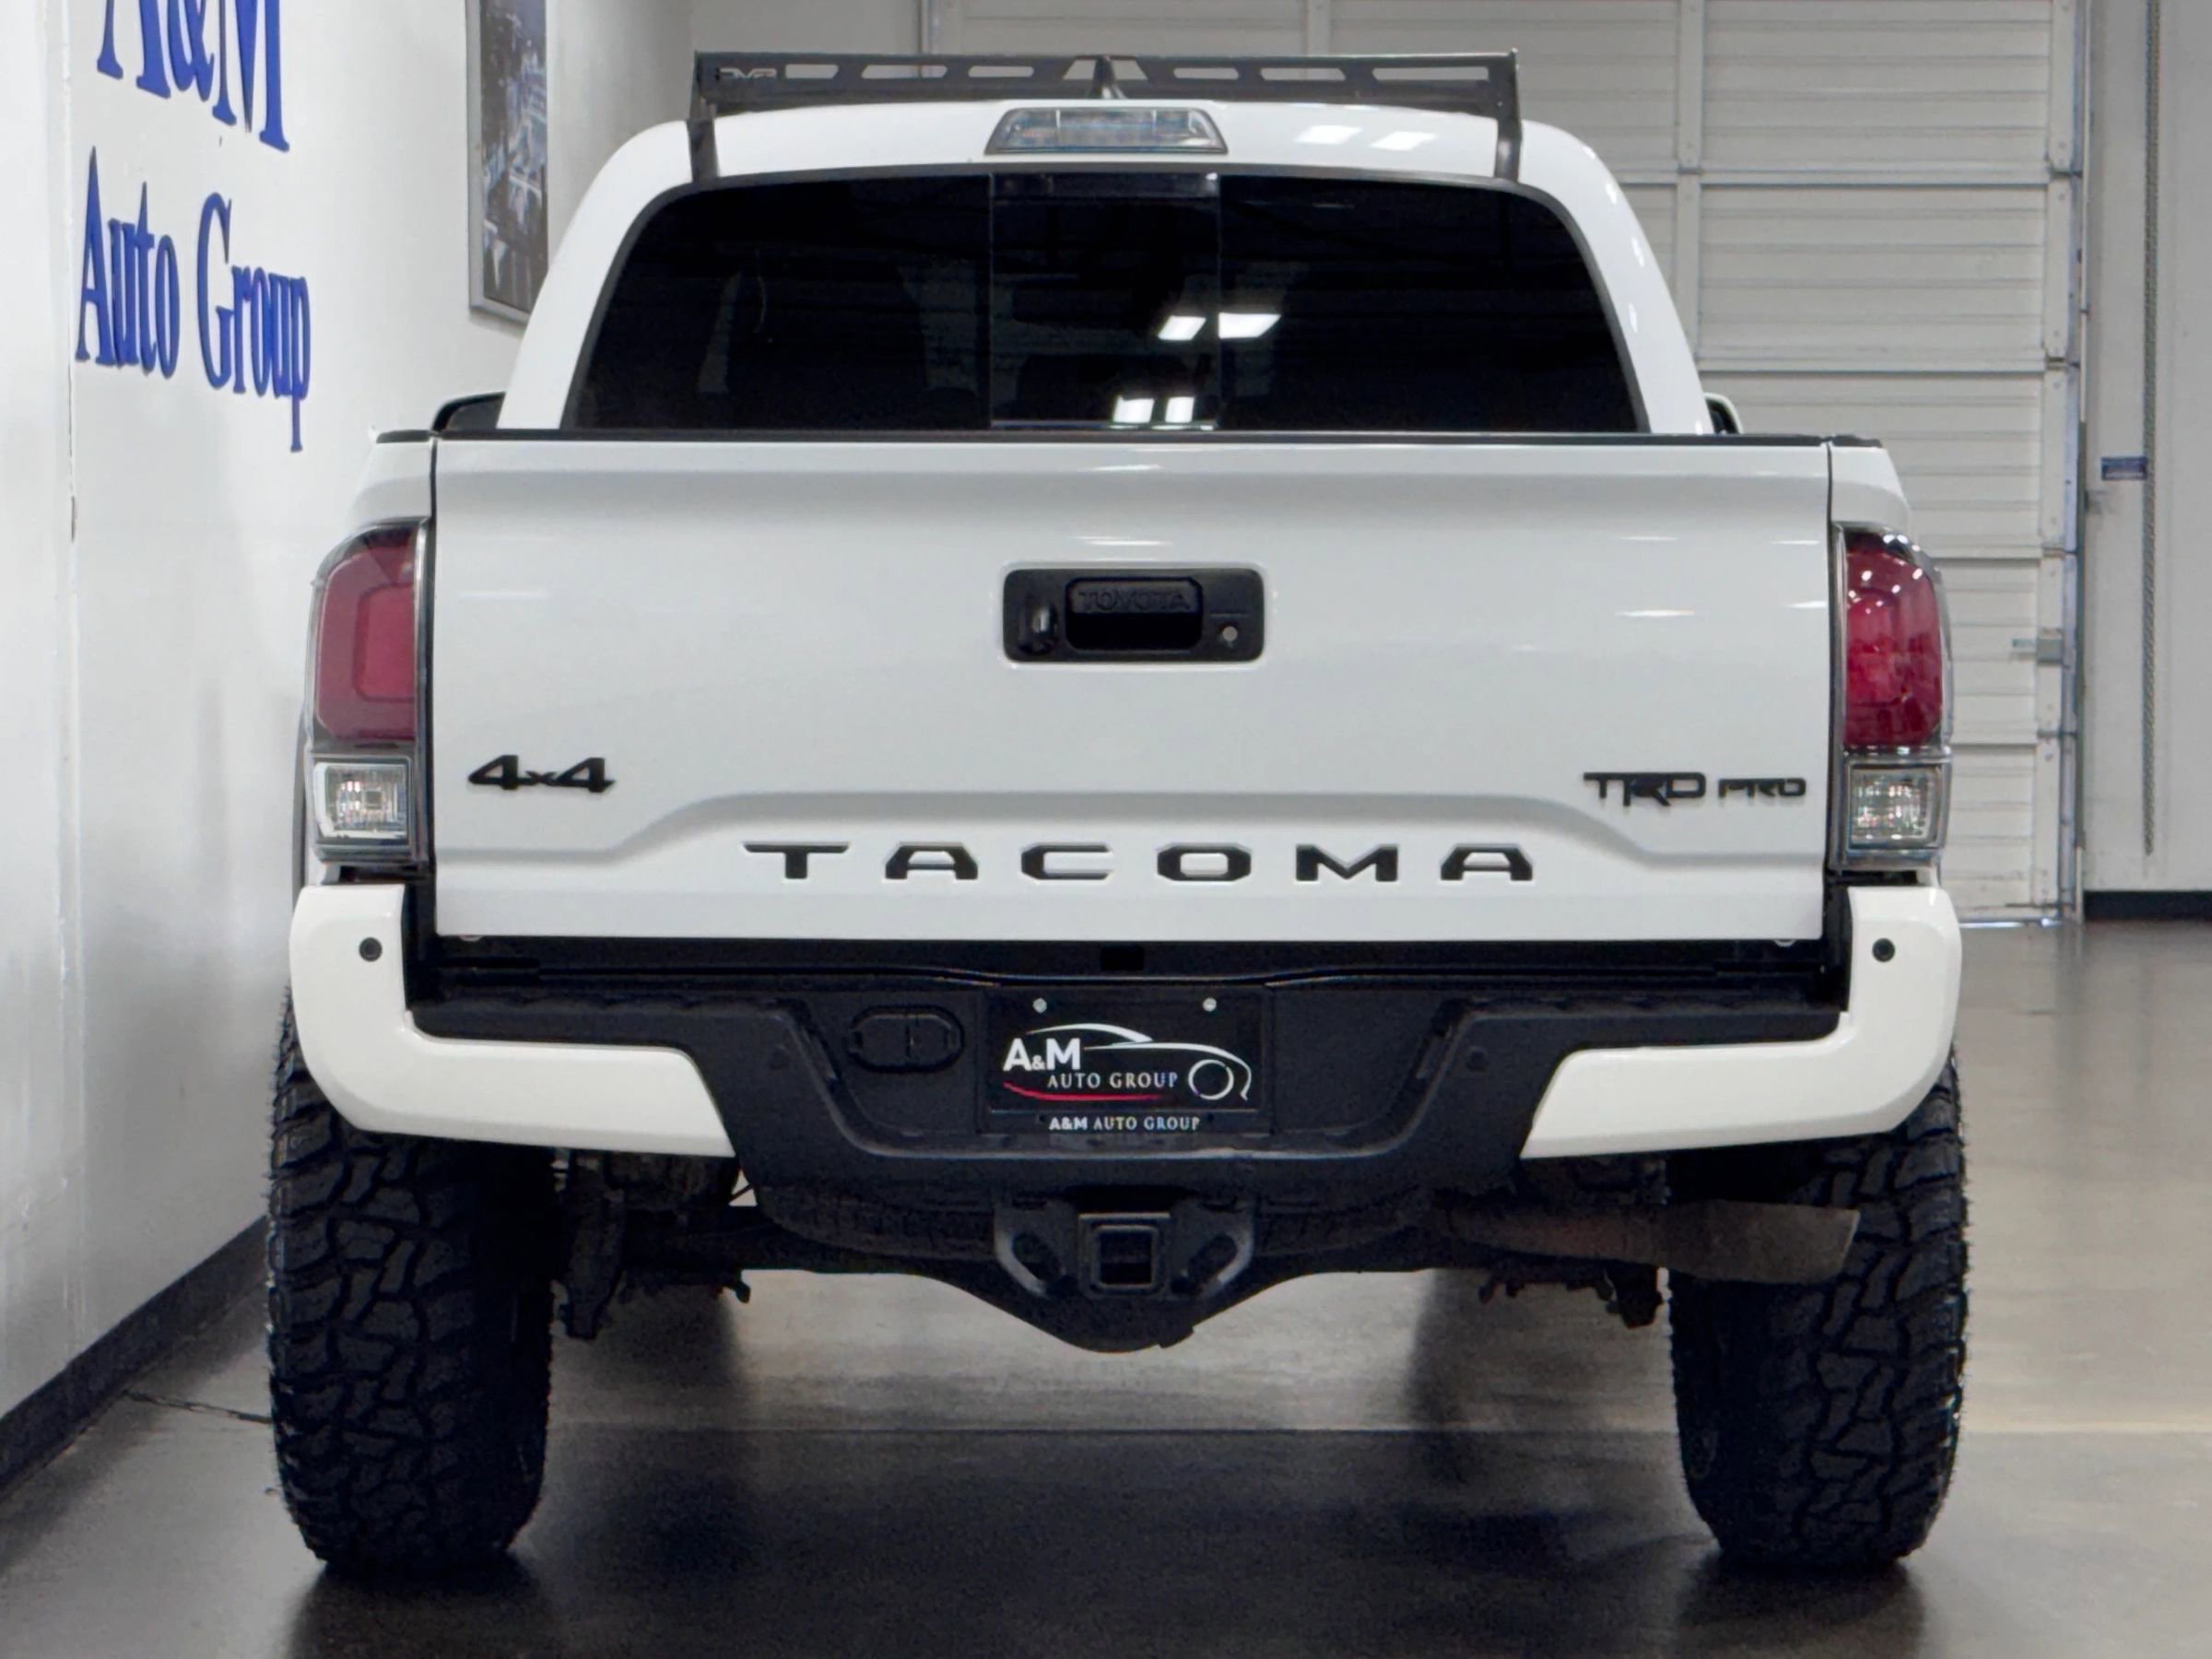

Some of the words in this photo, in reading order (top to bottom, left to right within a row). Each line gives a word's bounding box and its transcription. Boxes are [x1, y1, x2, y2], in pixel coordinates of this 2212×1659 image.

[75, 145, 181, 380] Auto
[196, 192, 312, 453] Group
[1077, 590, 1192, 612] TOYOTA
[1583, 771, 1707, 807] TRD
[1717, 777, 1806, 798] PRO
[744, 841, 1534, 882] TACOMA
[1002, 1037, 1081, 1072] A&M
[1046, 1072, 1101, 1088] AUTO
[1109, 1072, 1179, 1088] GROUP
[1048, 1116, 1088, 1131] A&M
[1093, 1116, 1138, 1131] AUTO
[1143, 1116, 1201, 1131] GROUP
